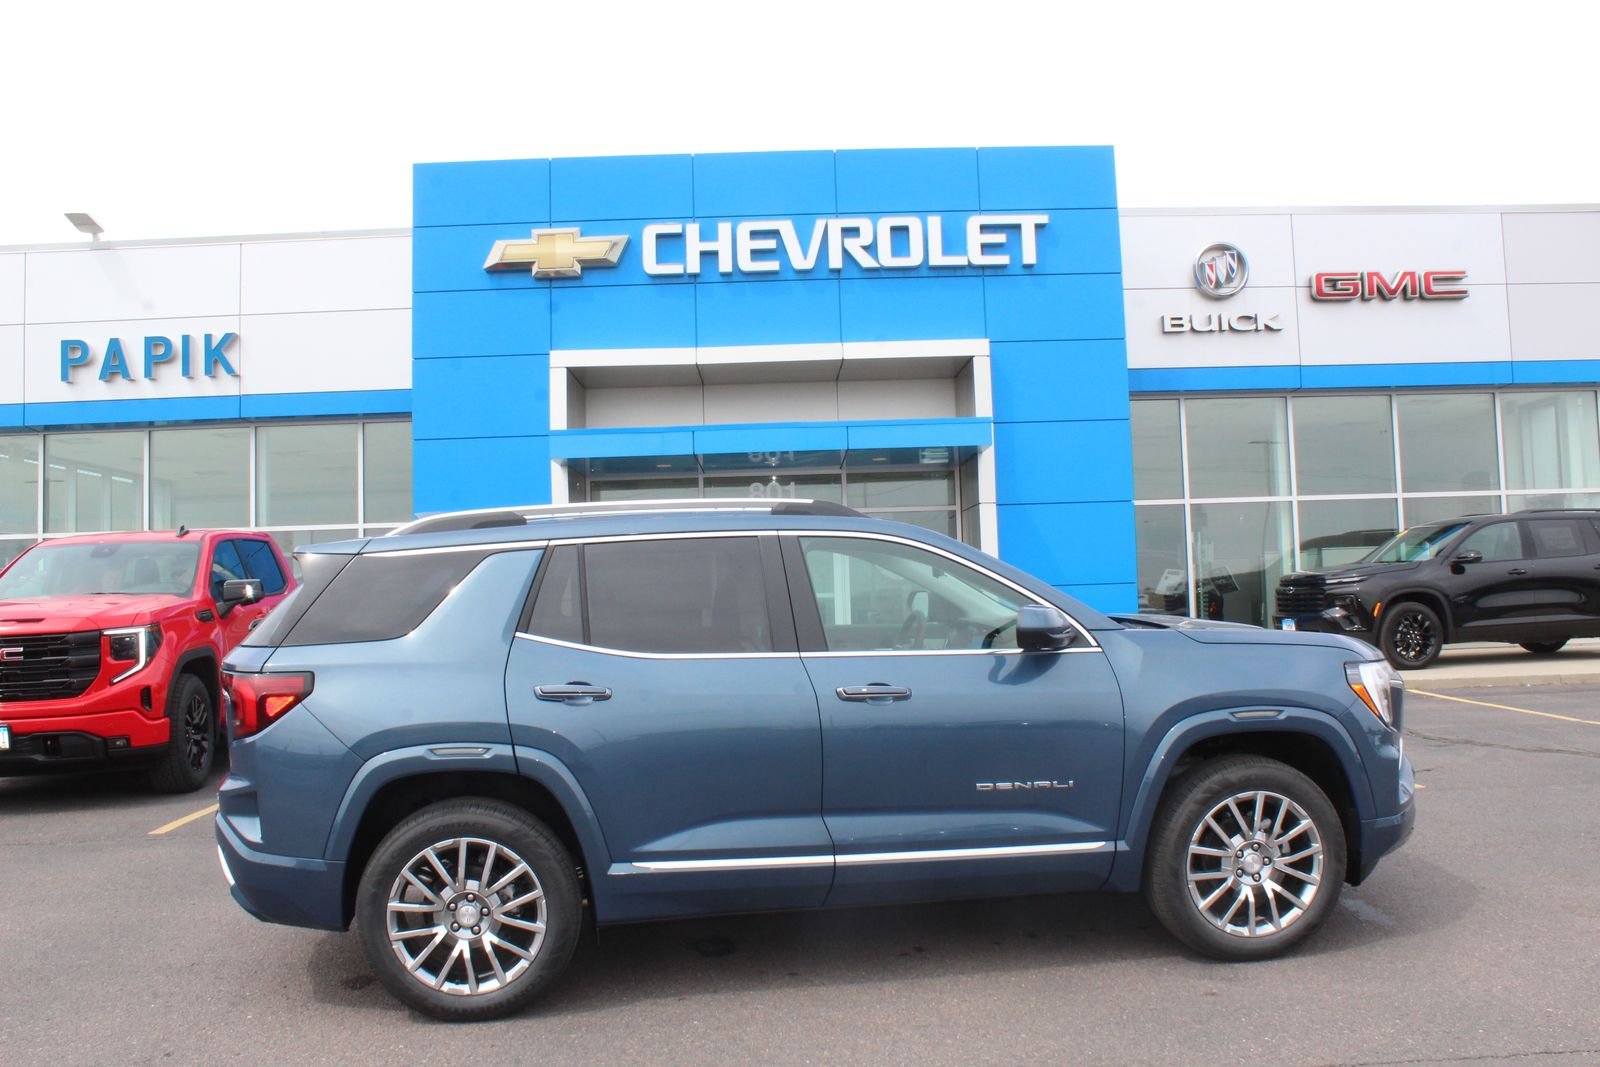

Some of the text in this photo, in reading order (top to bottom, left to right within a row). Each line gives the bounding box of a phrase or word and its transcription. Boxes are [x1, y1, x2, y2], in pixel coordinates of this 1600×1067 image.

[642, 214, 1049, 275] CHEVROLET
[1309, 270, 1469, 303] GMC
[1161, 312, 1283, 334] BUICK
[60, 332, 240, 384] PAPIK
[976, 780, 1074, 791] DENALI
